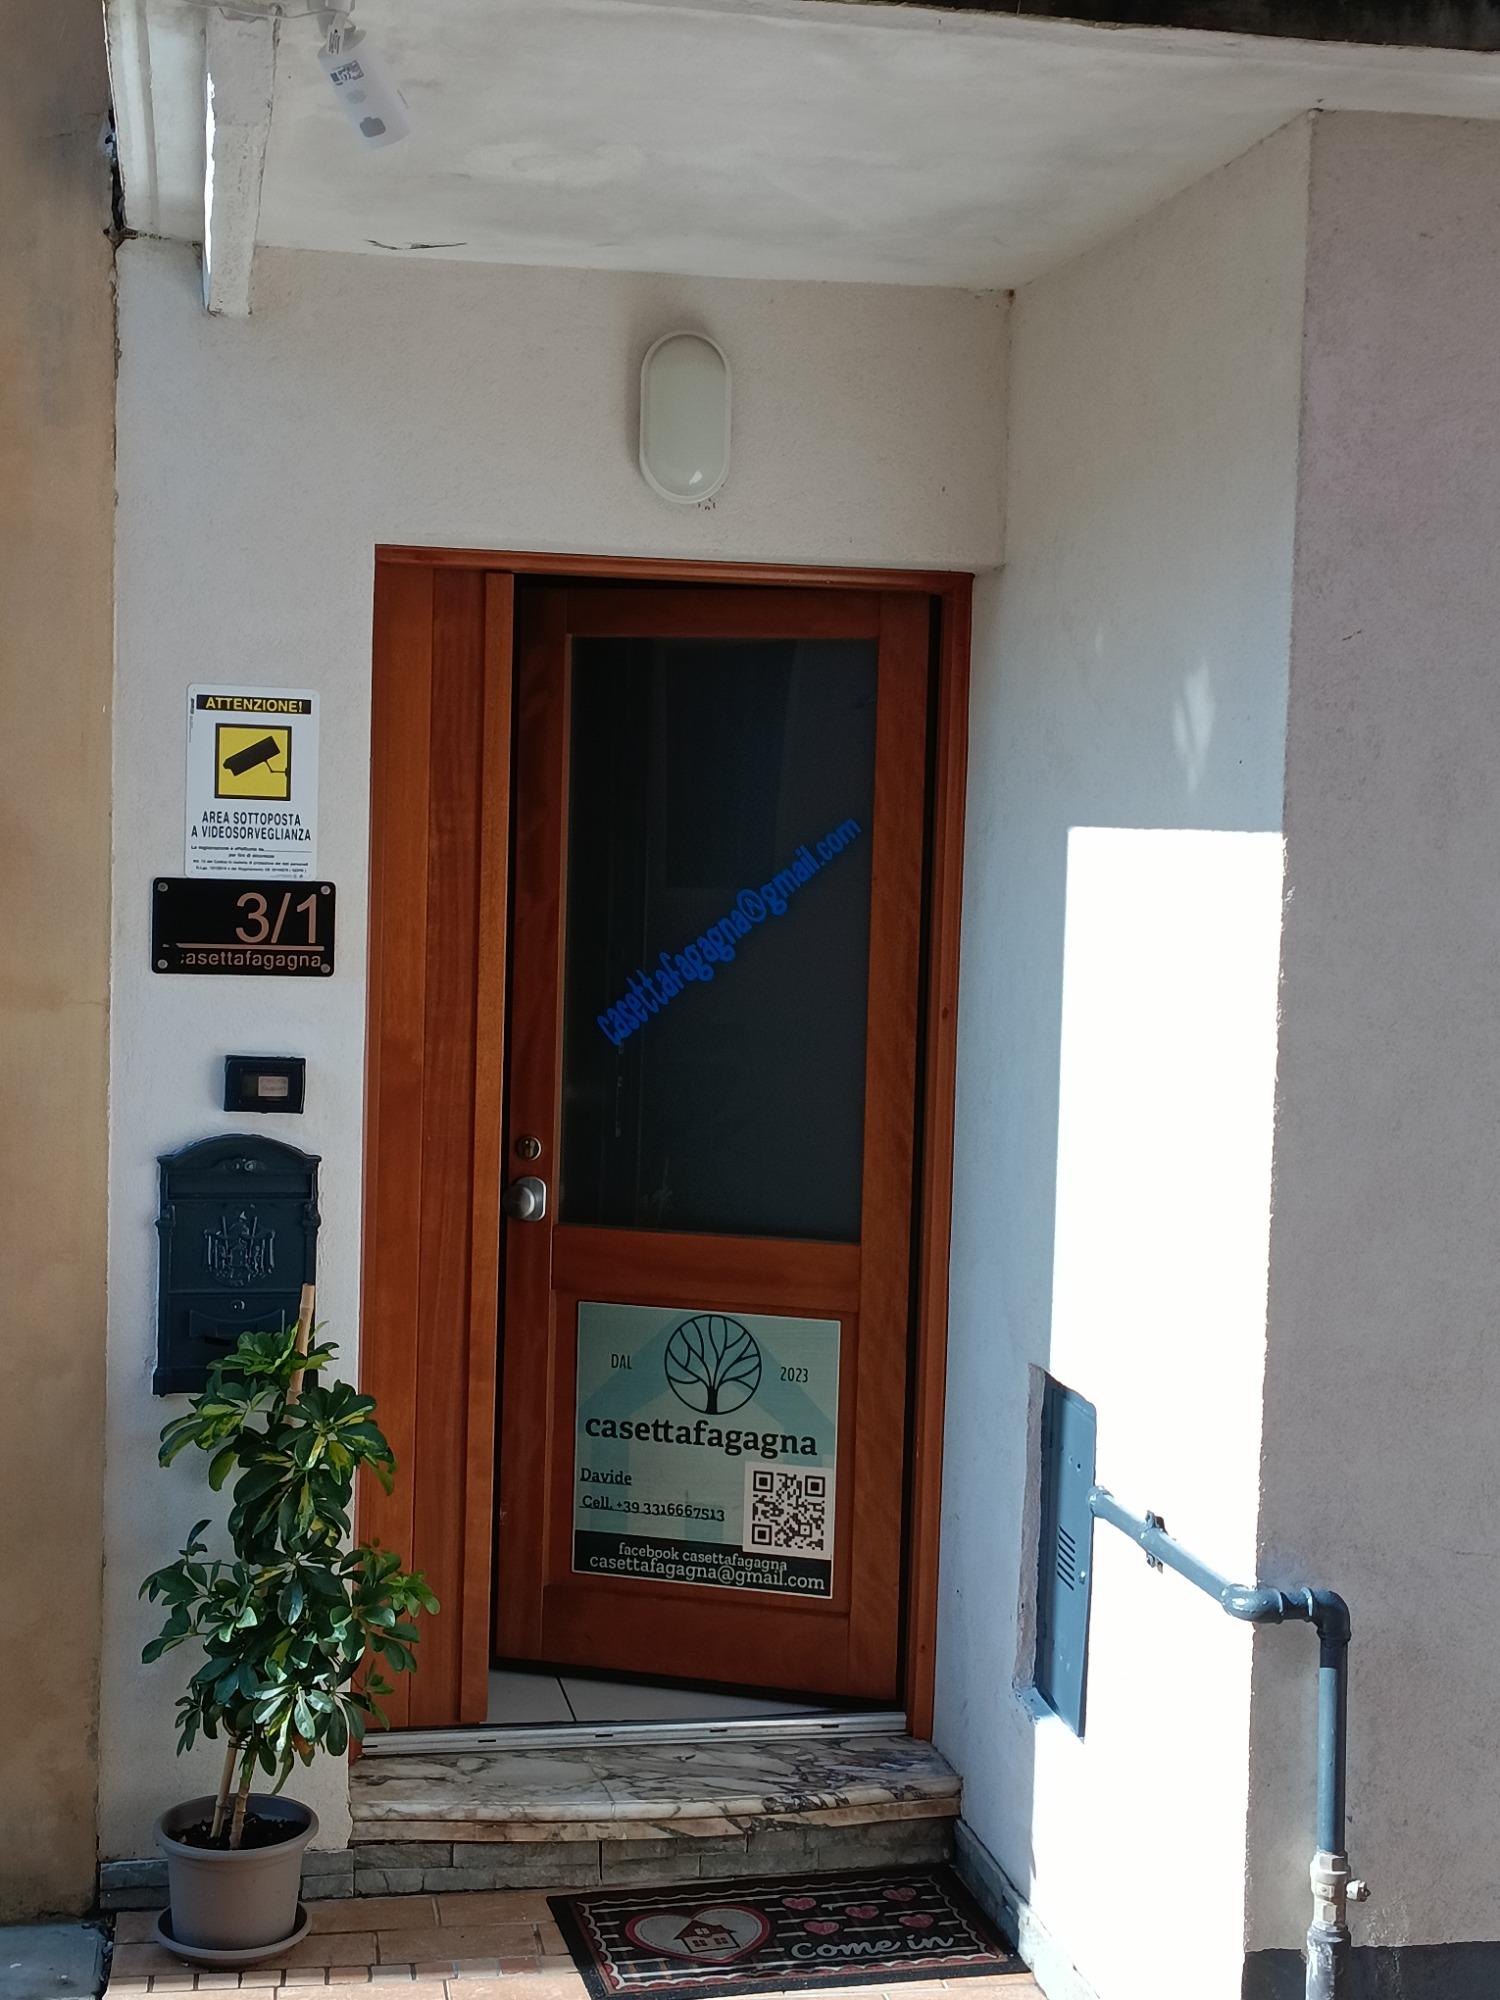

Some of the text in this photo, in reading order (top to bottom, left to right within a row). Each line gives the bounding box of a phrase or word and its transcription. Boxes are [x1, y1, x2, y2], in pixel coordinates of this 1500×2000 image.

[205, 696, 303, 713] ATTENZIONE!
[191, 825, 311, 841] A VIDEOSORVEGLIANZA
[202, 811, 301, 826] AREA SOTTOPOSTA
[235, 892, 317, 944] 3/1
[596, 818, 862, 1046] casettafagagna@gmail.com
[610, 1353, 809, 1384] DAL 2023
[585, 1416, 818, 1459] casettafagagna
[580, 1467, 633, 1486] Davide
[582, 1495, 725, 1522] Cell. +39 3316667513
[618, 1541, 788, 1573] facebook casettafagagna
[589, 1555, 825, 1590] casettafagagna@gmail.com
[791, 1934, 954, 1959] Come in
